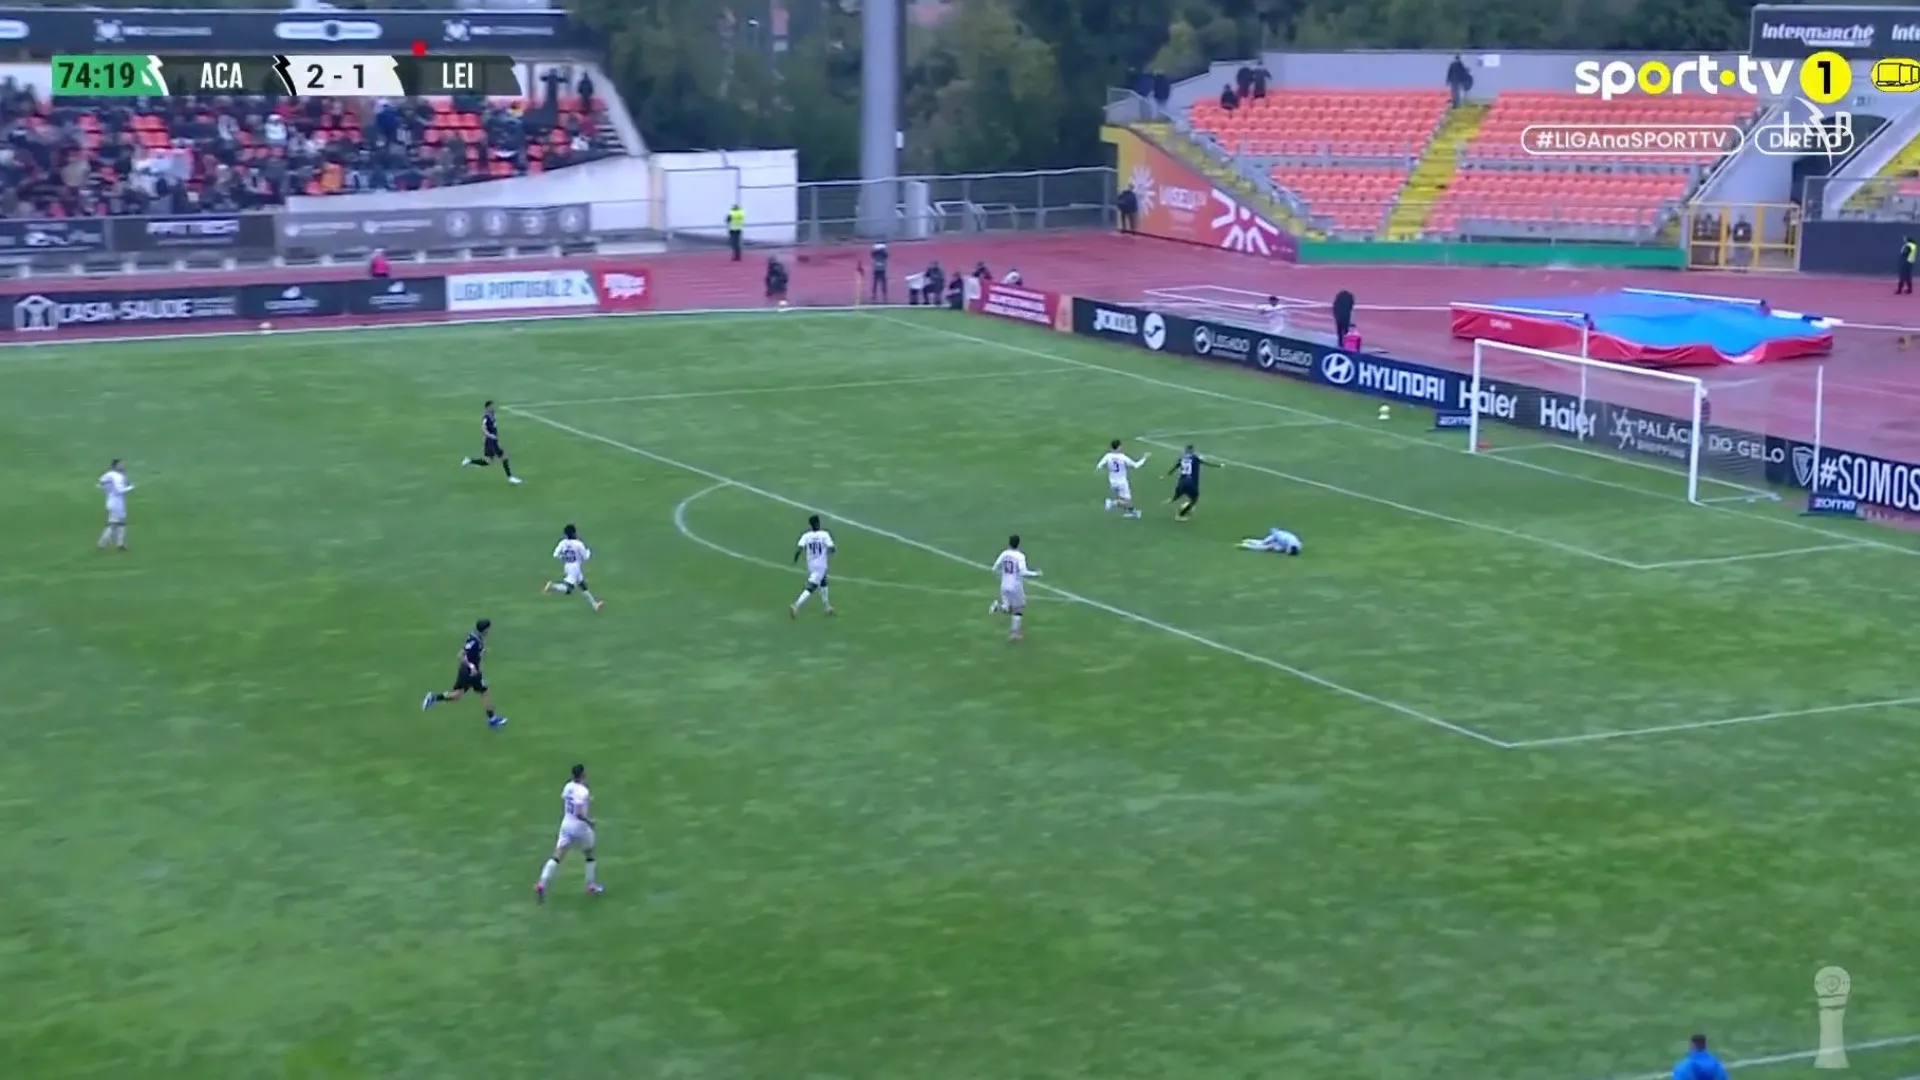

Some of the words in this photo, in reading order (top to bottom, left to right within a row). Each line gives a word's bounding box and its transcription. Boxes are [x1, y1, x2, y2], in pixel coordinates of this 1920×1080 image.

[1762, 22, 1875, 43] Intermarché
[1358, 362, 1445, 402] HYUNDAI
[1459, 380, 1518, 419] Haier
[1540, 396, 1597, 437] Haier
[1707, 434, 1733, 452] DO
[1737, 441, 1785, 463] GELO
[1819, 454, 1920, 511] #SOMOS
